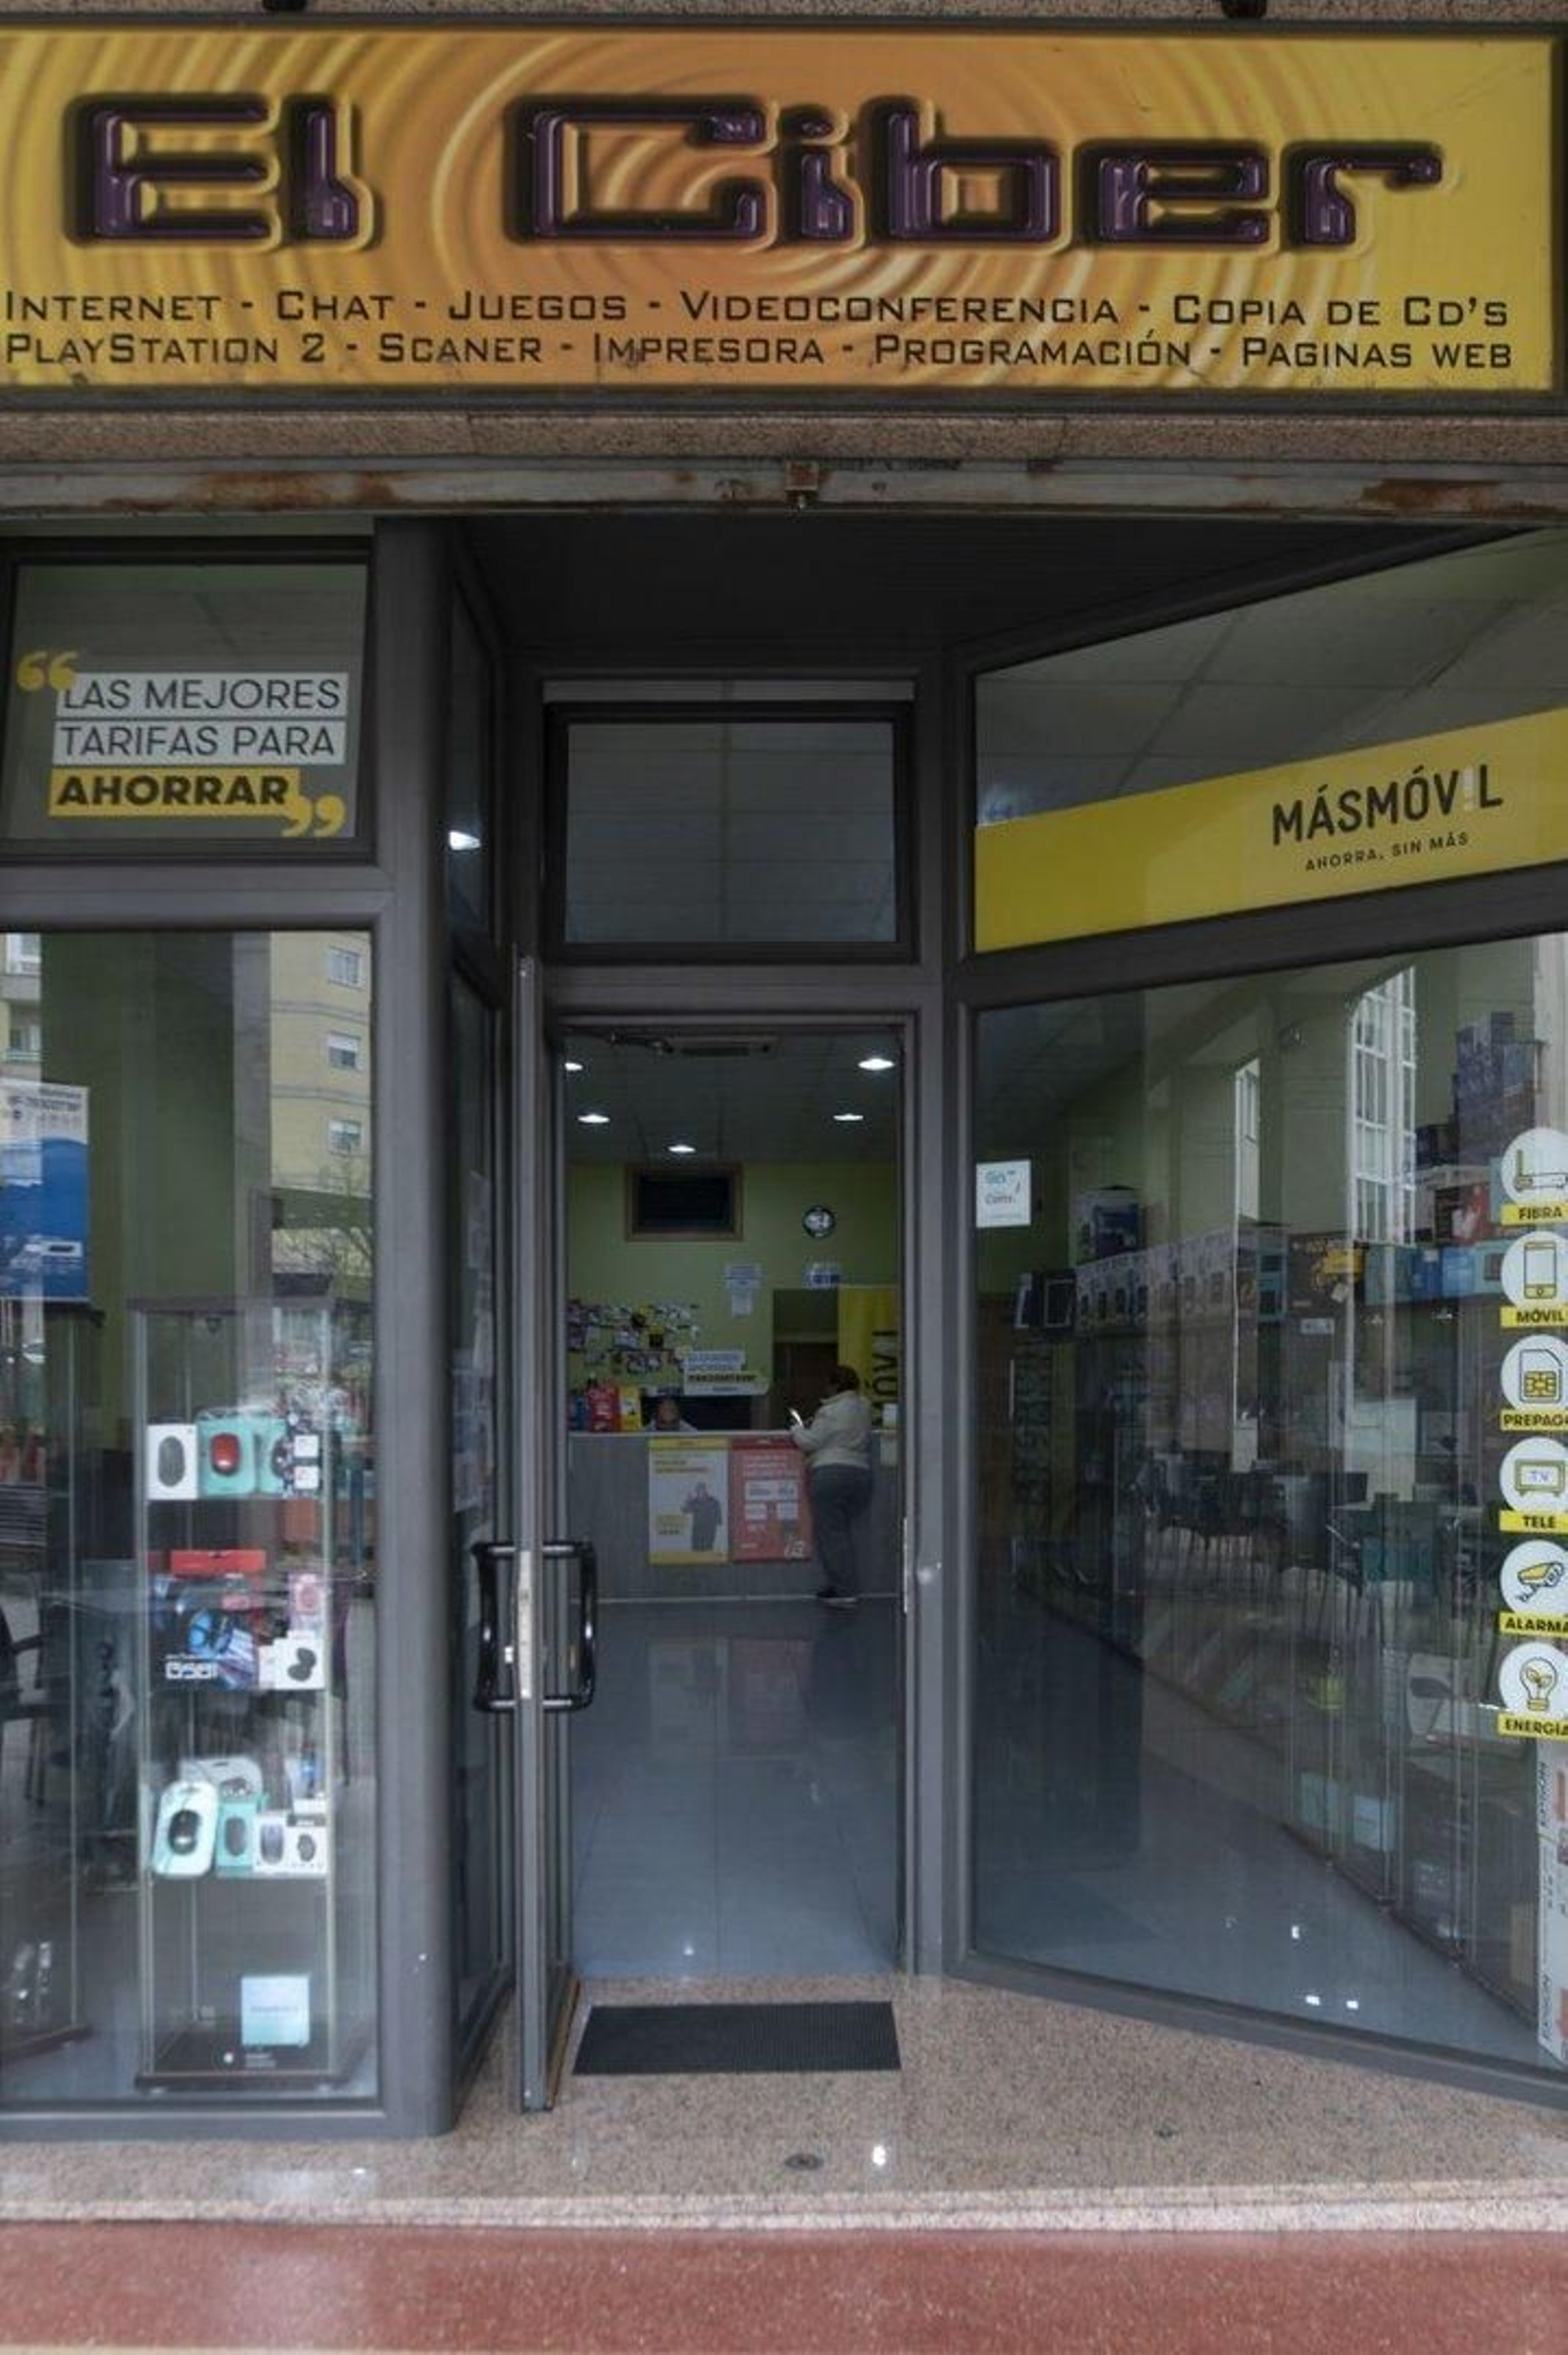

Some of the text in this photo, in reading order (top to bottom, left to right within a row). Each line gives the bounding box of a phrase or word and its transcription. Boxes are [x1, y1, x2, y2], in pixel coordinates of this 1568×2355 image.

[67, 95, 1446, 247] El Ciber
[6, 291, 221, 321] INTERNET
[276, 290, 394, 321] CHAT
[448, 291, 626, 321] JUEGOS
[680, 291, 1119, 324] VIDEOCONFERENCIA
[1173, 295, 1305, 326] COPIA
[6, 333, 278, 364] PLAYSTATION
[301, 334, 324, 363] 2
[378, 333, 542, 363] SCANER
[594, 334, 823, 365] IMPRESORA
[874, 330, 1191, 368] PROGRAMACIÓN
[1243, 339, 1411, 368] PAGINAS
[64, 679, 340, 710] LAS MEJORES
[61, 725, 334, 756] TARIFAS PARA
[56, 775, 289, 806] AHORRAR
[1393, 842, 1422, 858] SIN
[1430, 832, 1469, 851] MÁS
[1518, 1206, 1562, 1221] FIBRA
[1516, 1306, 1564, 1323] MÓVIL
[1503, 1414, 1568, 1427] PREPAG
[1523, 1515, 1556, 1529] TELE
